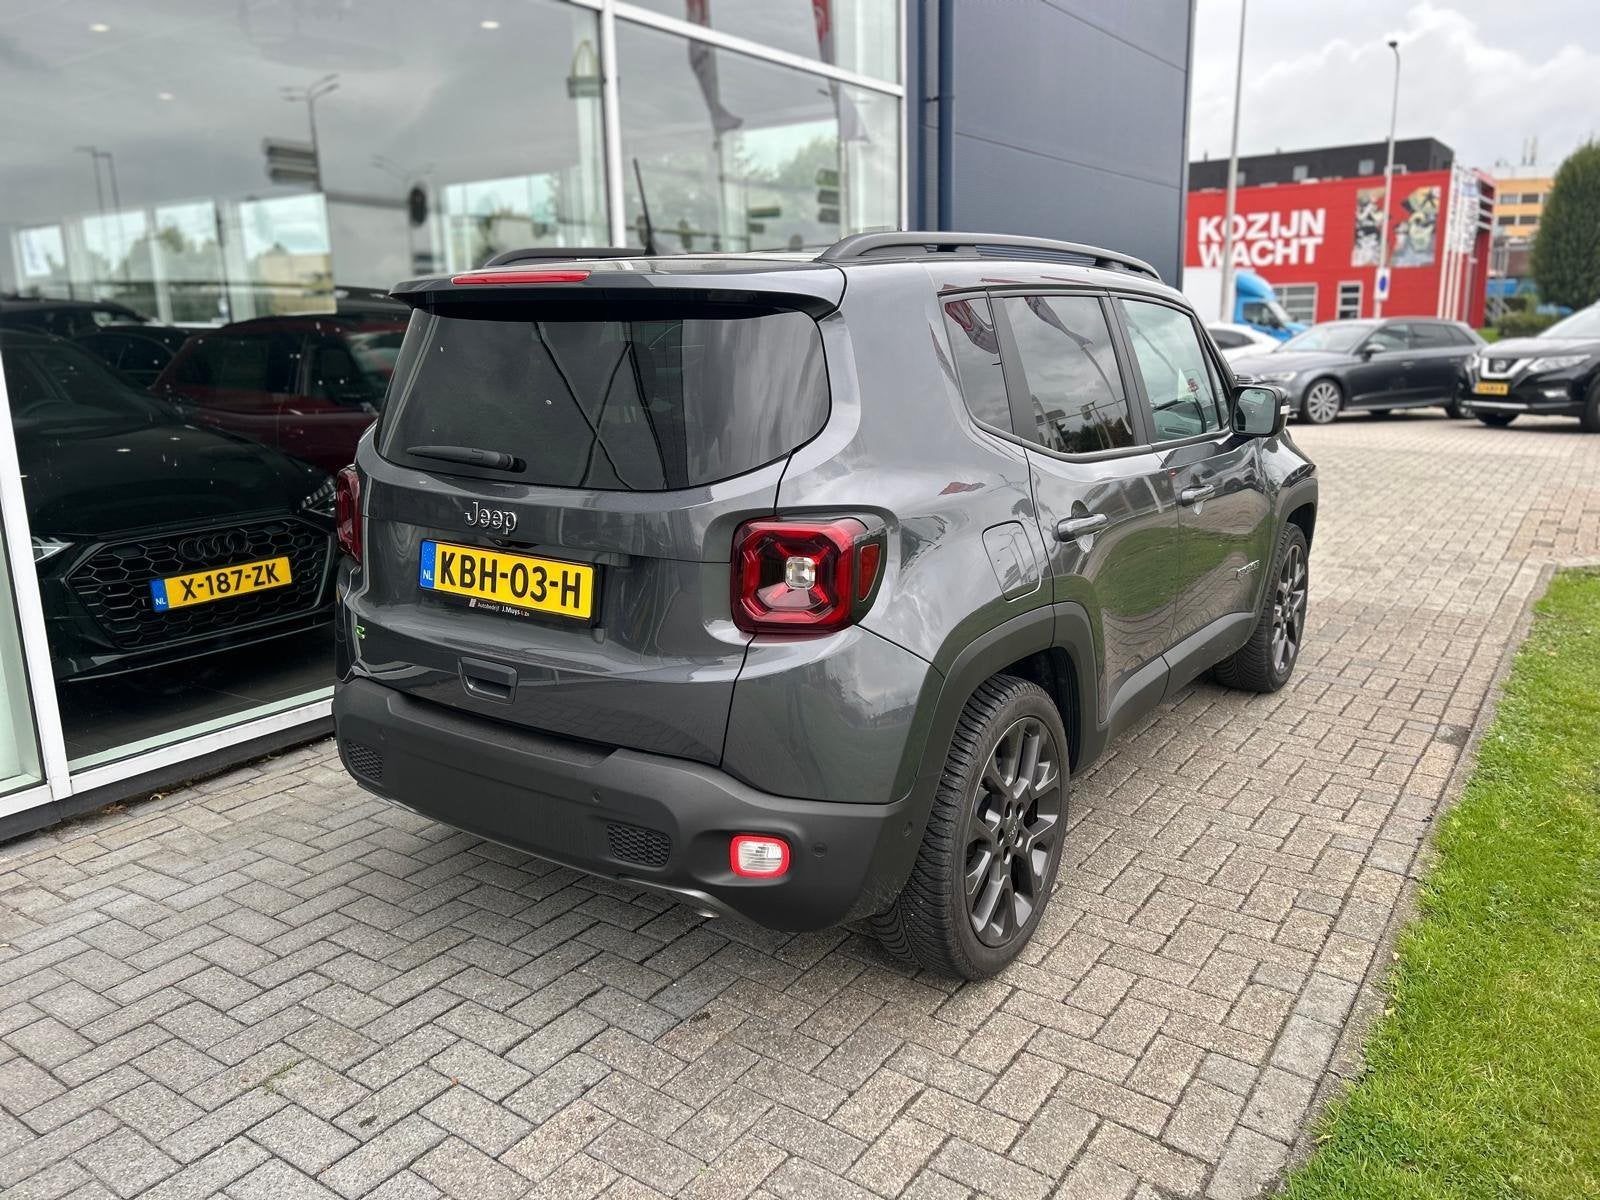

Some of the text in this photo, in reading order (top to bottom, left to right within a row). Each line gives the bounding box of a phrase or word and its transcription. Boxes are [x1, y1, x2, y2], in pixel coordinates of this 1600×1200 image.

[1198, 208, 1326, 242] KOZIJN
[1198, 236, 1324, 267] WACHT
[464, 501, 518, 535] Jeep
[155, 563, 280, 606] NL X-187-ZK
[422, 550, 581, 609] NL KBH-03-H
